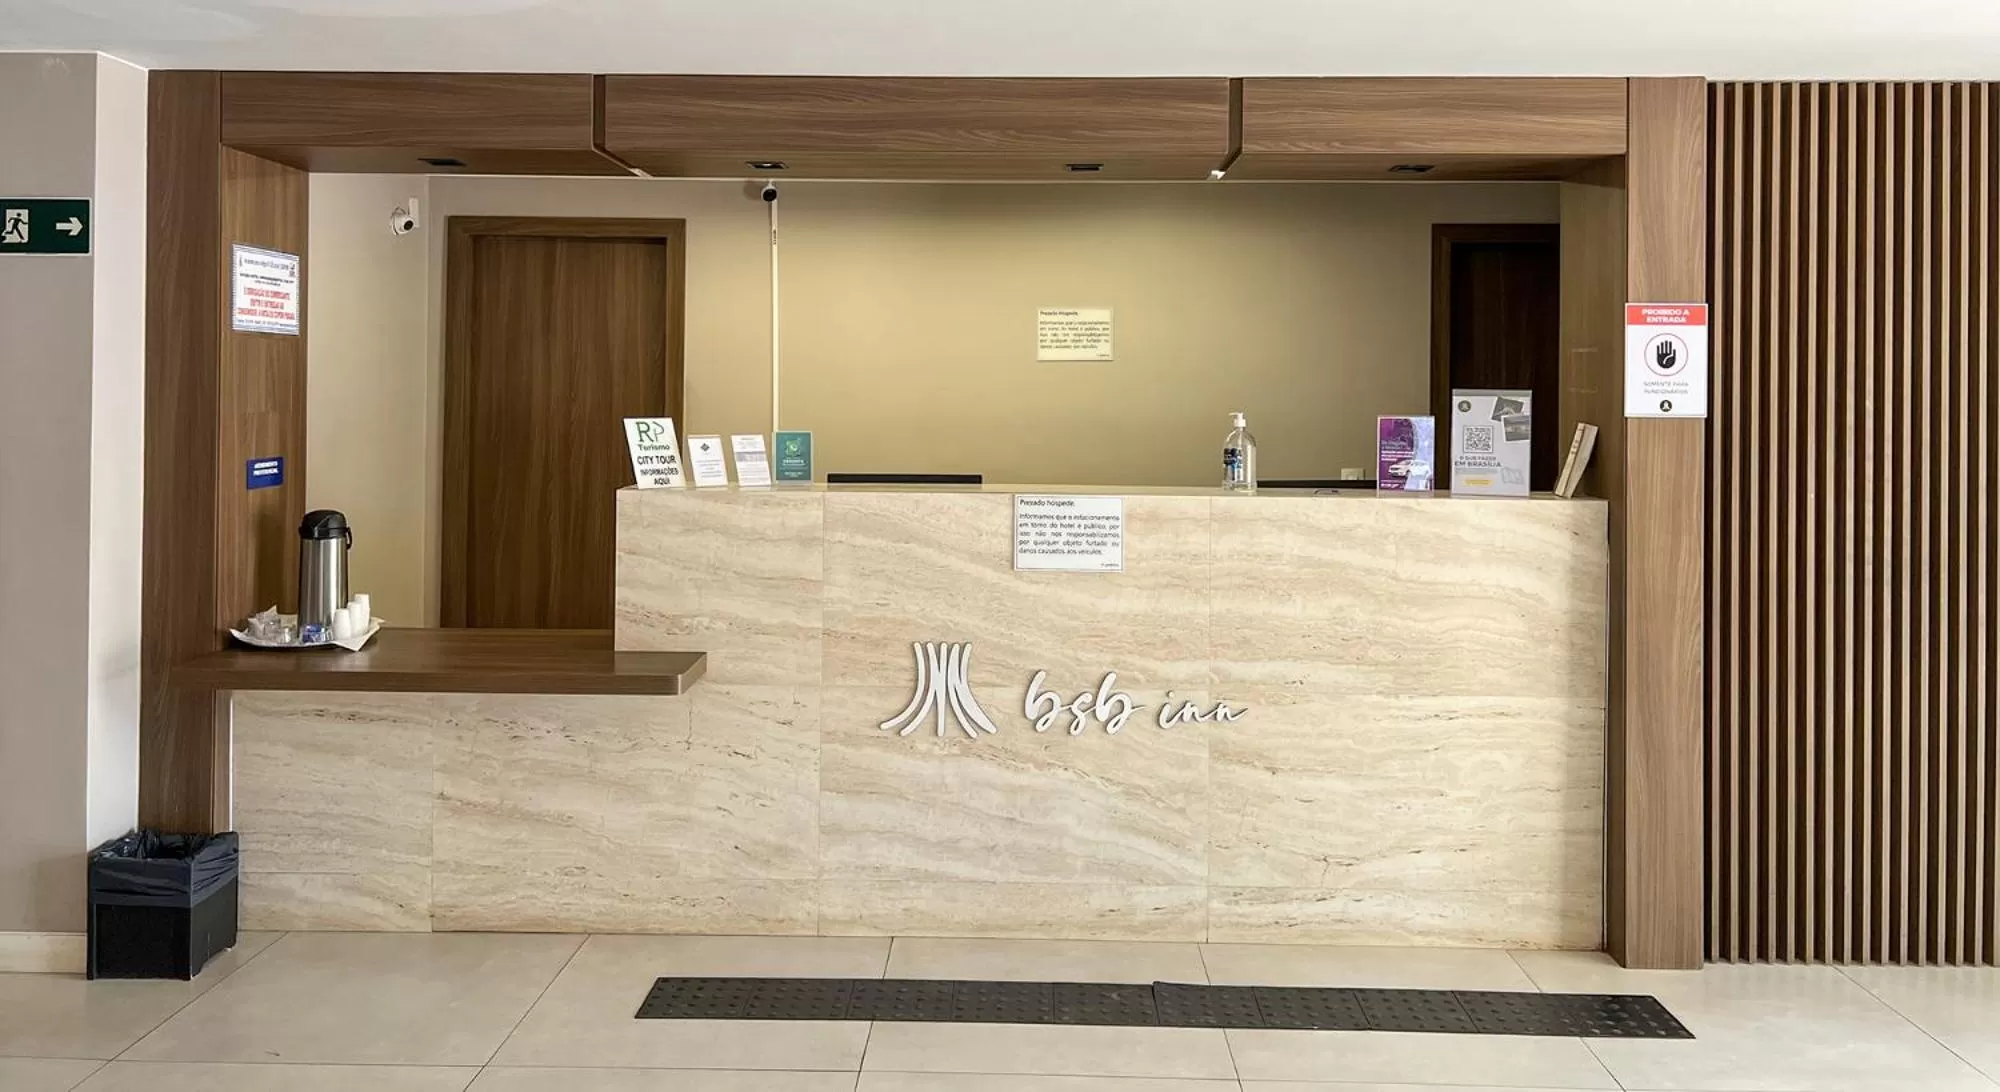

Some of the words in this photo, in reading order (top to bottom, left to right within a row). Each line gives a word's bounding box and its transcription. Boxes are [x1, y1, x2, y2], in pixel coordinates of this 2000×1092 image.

[637, 456, 654, 465] CITY
[656, 455, 677, 464] TOUR
[1020, 499, 1046, 507] Prezado
[1024, 669, 1147, 737] bsb
[1156, 690, 1249, 731] inn
